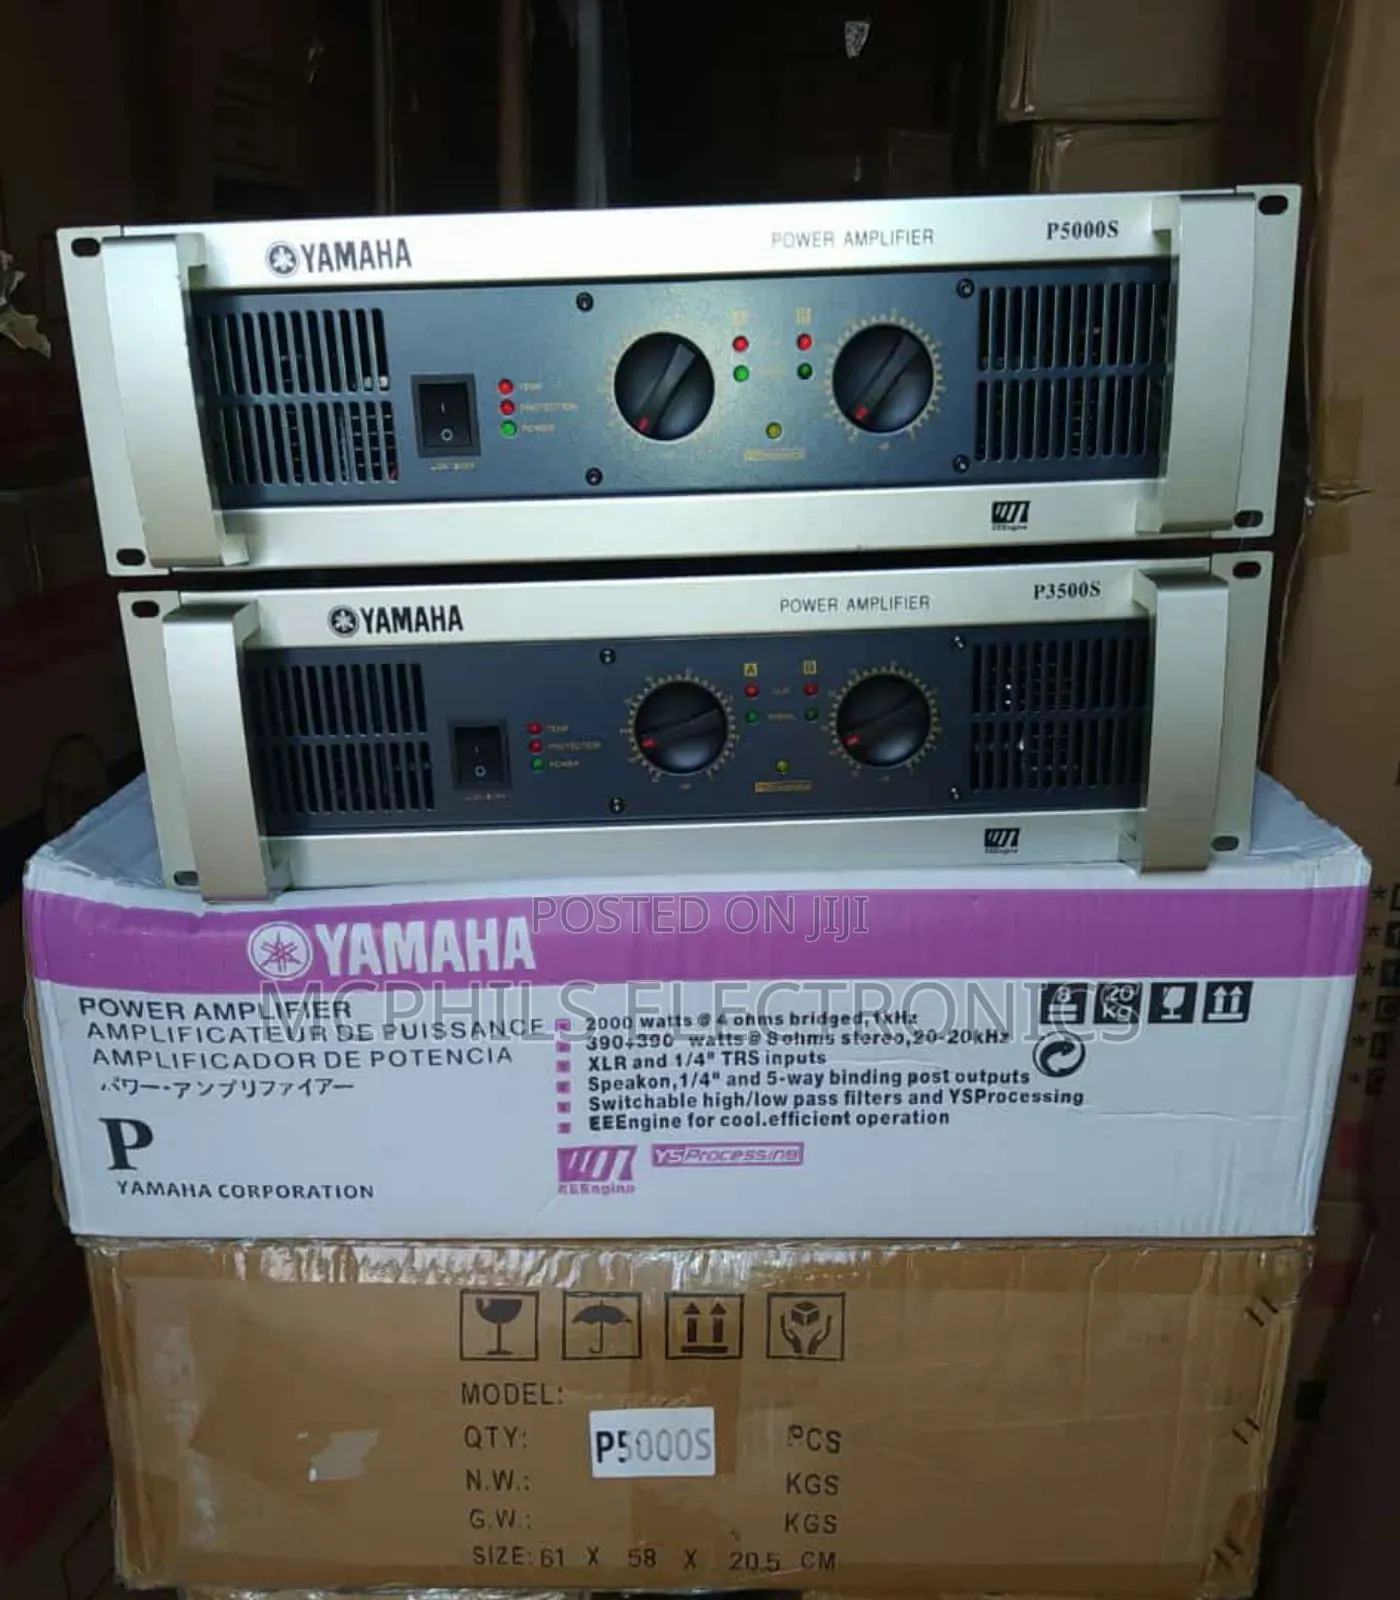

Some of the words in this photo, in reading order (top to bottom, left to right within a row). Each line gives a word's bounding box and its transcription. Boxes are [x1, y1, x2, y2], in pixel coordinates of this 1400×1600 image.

[771, 231, 835, 249] POWER
[843, 228, 935, 247] AMPLIFIER
[1046, 220, 1120, 241] P5000S
[301, 237, 412, 273] YAMAHA
[1033, 580, 1102, 601] P3500S
[780, 597, 839, 614] POWER
[846, 594, 931, 613] AMPLIFIER
[360, 604, 464, 634] YAMAHA
[316, 916, 536, 977] YAMAHA
[79, 997, 185, 1022] POWER
[193, 1000, 352, 1021] AMPLIFIER
[585, 1016, 633, 1032] 2000
[640, 1014, 692, 1029] watts
[733, 1012, 784, 1027] ohms
[86, 1021, 327, 1046] AMPLIFICATEUR
[337, 1023, 375, 1043] DE
[383, 1018, 544, 1040] PUISSANCE
[689, 1032, 743, 1048] watts
[781, 1029, 835, 1047] ohms
[92, 1047, 317, 1070] AMPLIFICADOR
[324, 1050, 361, 1069] DE
[371, 1046, 513, 1068] POTENCIA
[588, 1055, 628, 1072] XLR
[632, 1053, 668, 1070] and
[675, 1050, 715, 1068] 1/4"
[721, 1050, 760, 1067] TRS
[764, 1049, 827, 1068] inputs
[726, 1071, 761, 1087] and
[766, 1070, 824, 1089] 5-way
[829, 1069, 902, 1087] binding
[907, 1069, 949, 1085] post
[954, 1069, 1031, 1085] outputs
[588, 1093, 698, 1113] Switchable
[702, 1090, 788, 1111] high/low
[793, 1091, 838, 1109] pass
[843, 1089, 902, 1105] filters
[907, 1089, 943, 1105] and
[949, 1088, 1085, 1107] YSProcessing
[588, 1113, 682, 1133] EEEngine
[687, 1112, 715, 1129] for
[719, 1109, 851, 1128] cool.efficient
[855, 1110, 951, 1127] operation
[98, 1117, 154, 1171] P
[117, 1180, 213, 1199] YAMAHA
[218, 1182, 375, 1200] CORPORATION
[461, 1381, 564, 1406] MODEL:
[464, 1424, 528, 1450] QTY:
[787, 1424, 843, 1454] PCS
[595, 1428, 713, 1464] P5000S
[466, 1469, 531, 1492] N.W.:
[785, 1470, 841, 1496] KGS
[469, 1508, 532, 1531] G.W.:
[784, 1510, 838, 1534] KGS
[472, 1545, 534, 1567] SIZE:
[540, 1549, 566, 1568] 61
[586, 1545, 601, 1566] X
[627, 1549, 658, 1569] 58
[683, 1549, 698, 1570] X
[729, 1551, 781, 1573] 20.5
[801, 1551, 837, 1571] CM
